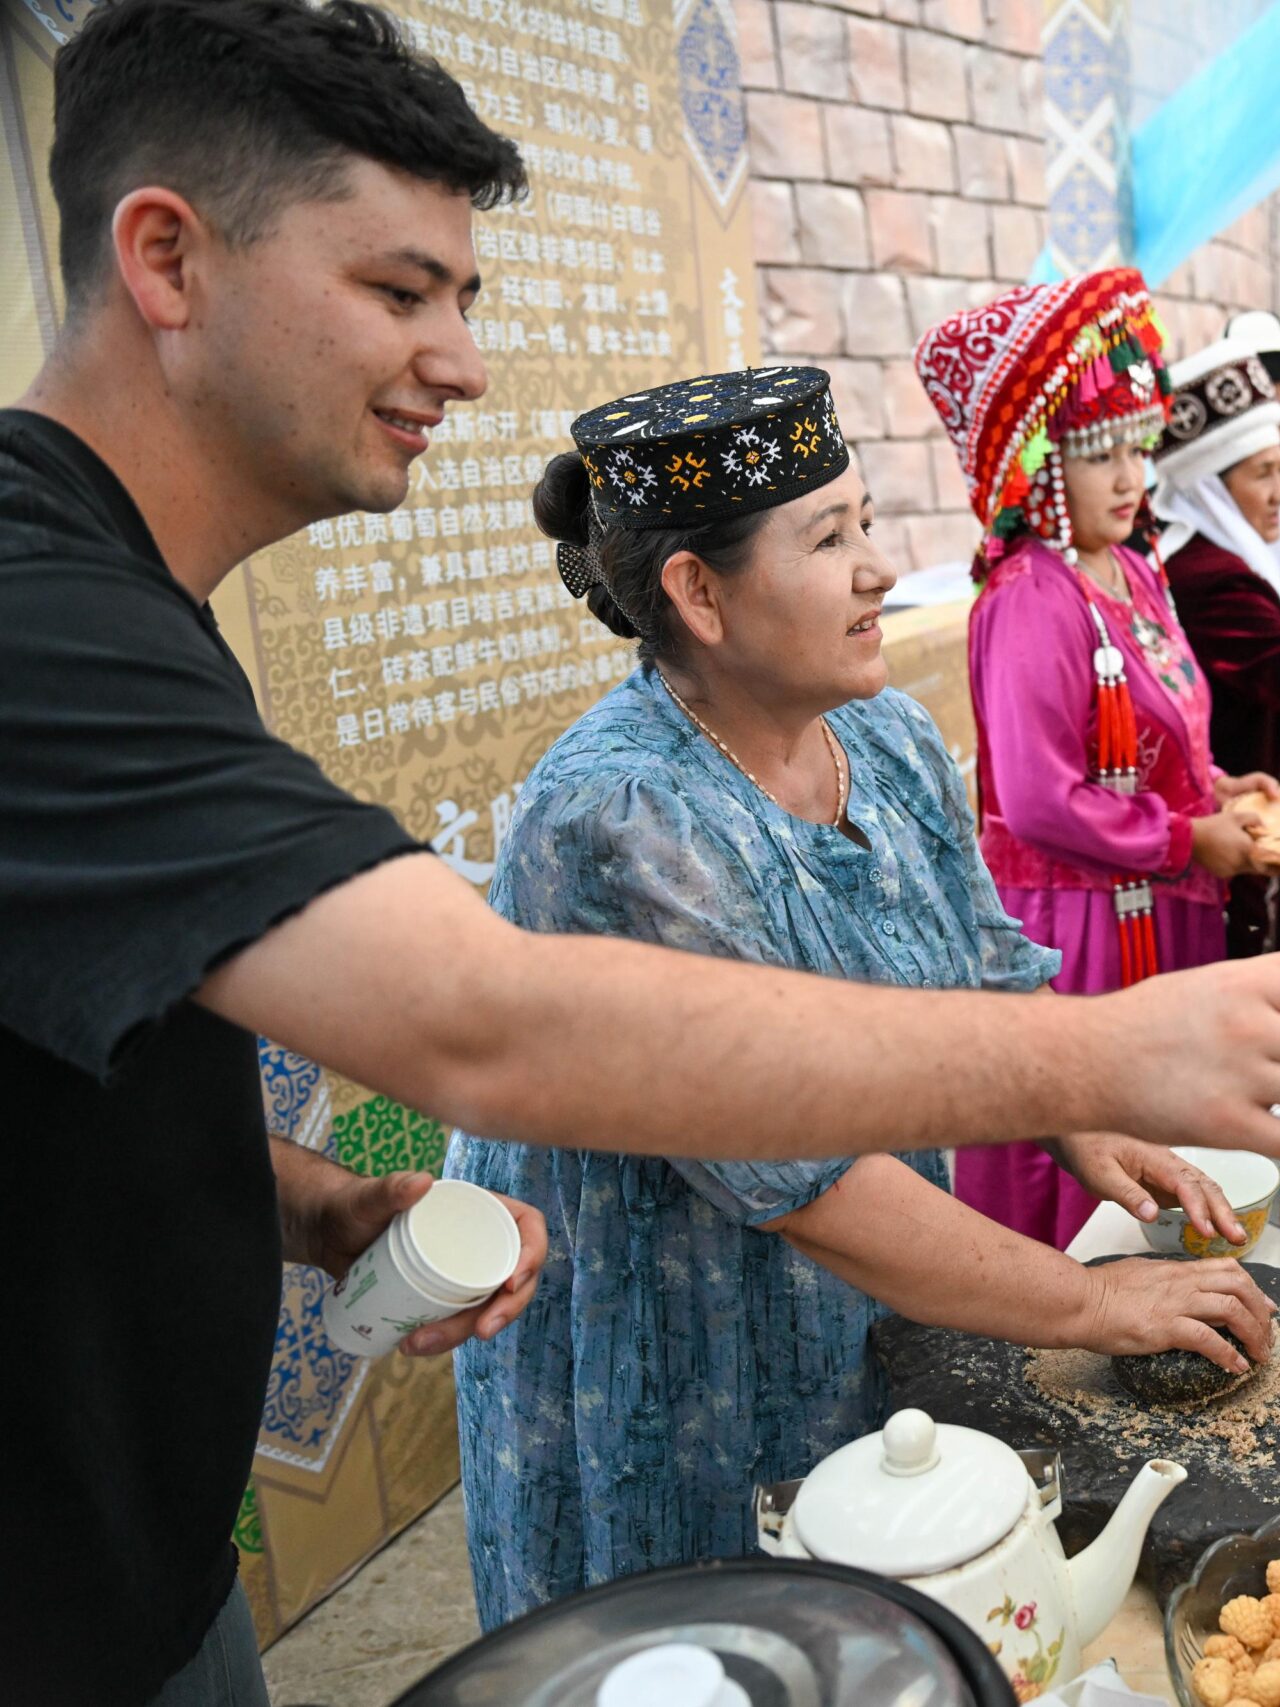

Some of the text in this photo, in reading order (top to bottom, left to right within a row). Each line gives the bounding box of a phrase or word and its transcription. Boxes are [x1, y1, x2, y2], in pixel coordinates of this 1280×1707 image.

[408, 453, 556, 491] 入选自治区级
[305, 499, 535, 550] 地优质葡萄自然发酵
[328, 617, 612, 700] 仁、砖茶配鲜牛奶熬制，口
